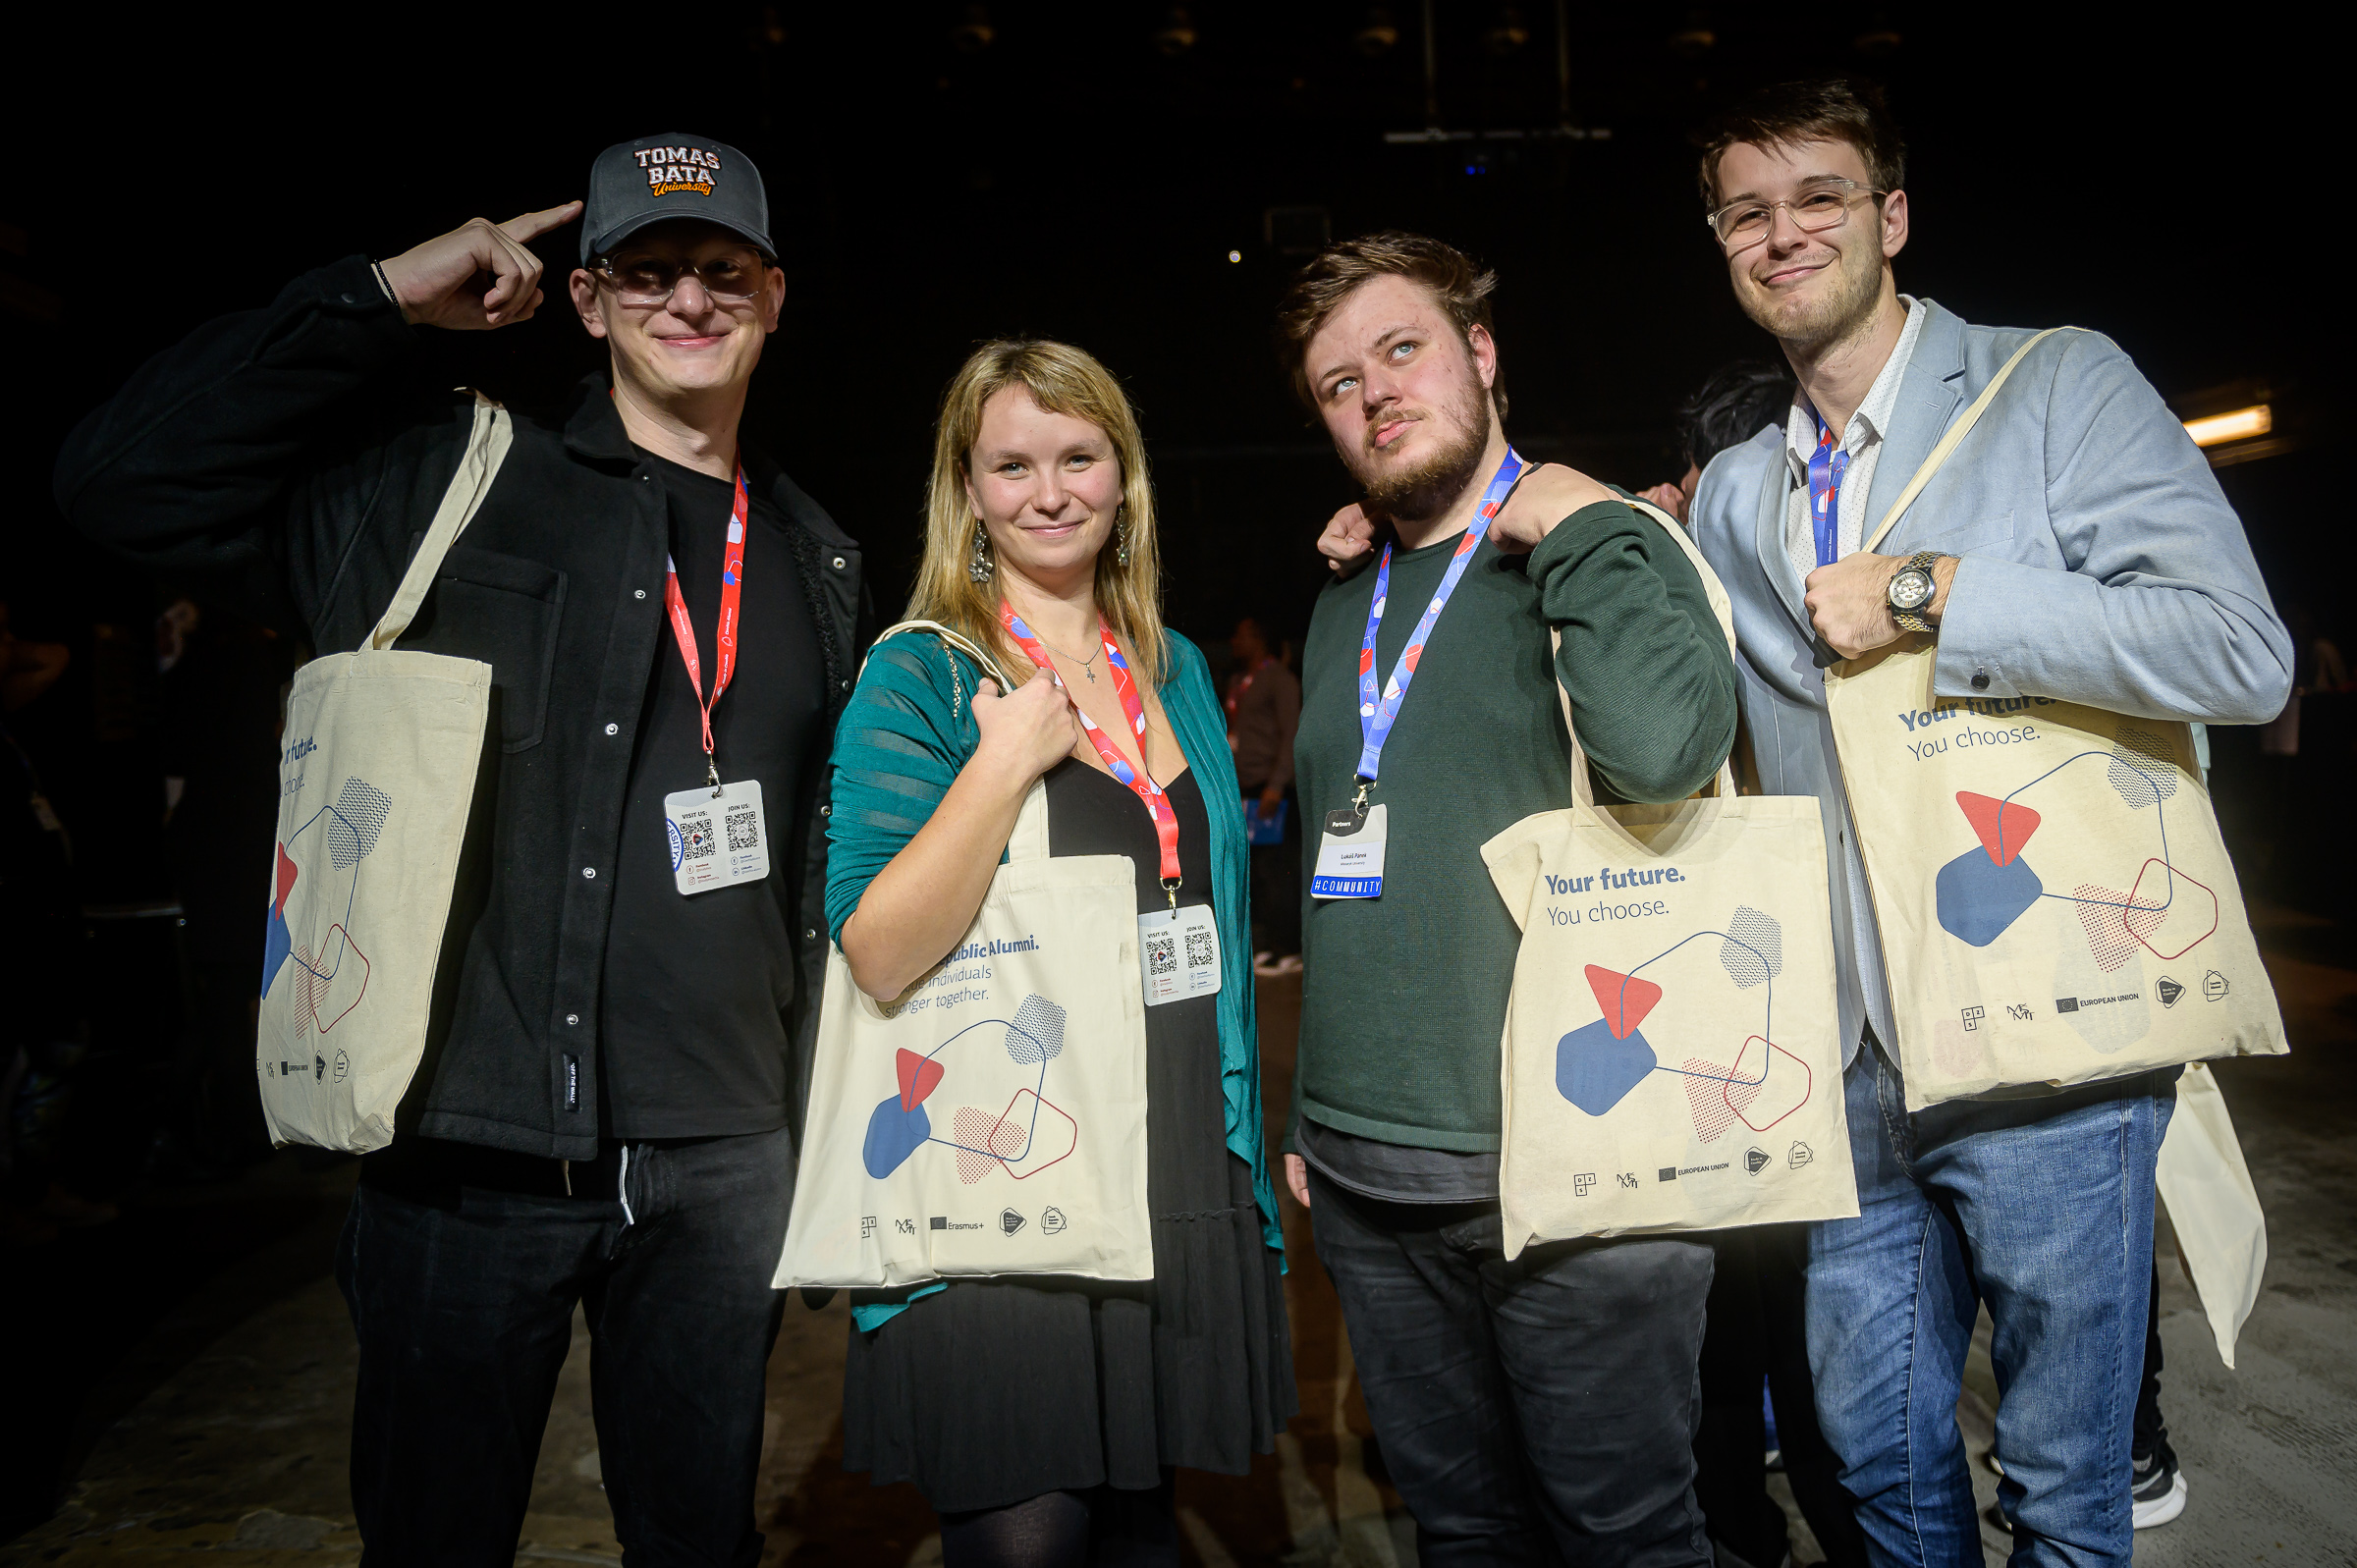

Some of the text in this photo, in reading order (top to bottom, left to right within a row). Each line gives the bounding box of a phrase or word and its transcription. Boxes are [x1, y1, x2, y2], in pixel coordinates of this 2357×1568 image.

[634, 146, 721, 170] TOMAS
[647, 165, 716, 186] BATA
[651, 181, 712, 196] University
[1898, 701, 1959, 731] Your
[1907, 726, 2041, 761] You choose.
[1314, 880, 1381, 892] #COMMUNITY
[1545, 867, 1685, 895] Your future.
[1547, 900, 1670, 926] You choose.
[989, 935, 1040, 956] Alumni.
[928, 965, 992, 988] individuals
[885, 987, 989, 1018] stronger together.
[2079, 993, 2139, 1007] EUROPEAN UNION
[1677, 1162, 1729, 1175] EUROPEAN UNION
